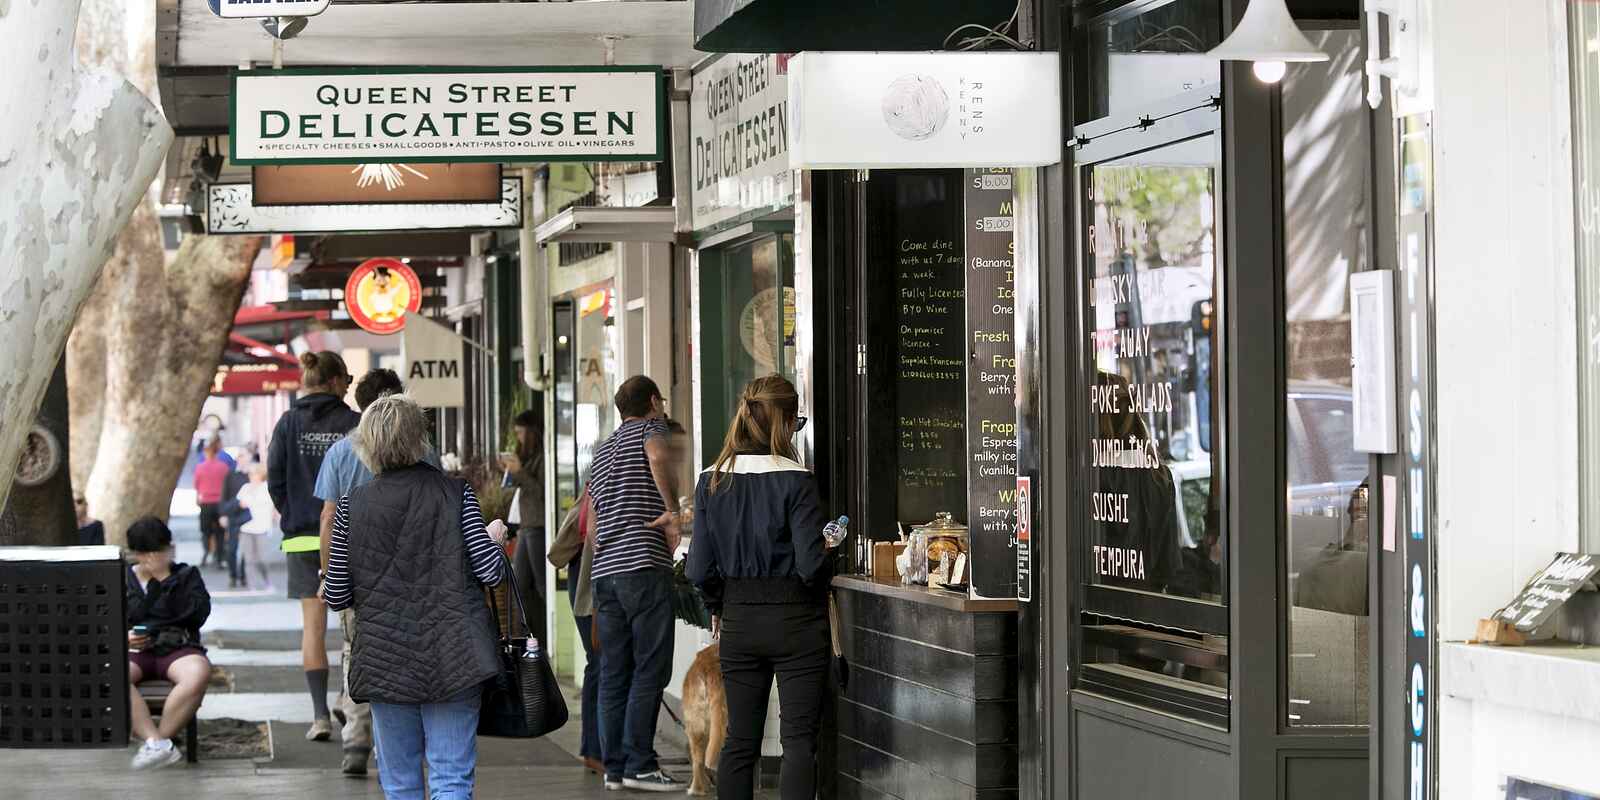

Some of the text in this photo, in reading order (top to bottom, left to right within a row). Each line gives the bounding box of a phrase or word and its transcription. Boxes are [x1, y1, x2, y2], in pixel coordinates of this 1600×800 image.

[316, 83, 577, 108] QUEEN STREET
[706, 54, 771, 120] QUEEN STREET
[972, 82, 983, 133] RENS
[259, 110, 635, 139] DELICATESSEN
[265, 143, 319, 151] SPECIALTY
[323, 142, 371, 150] CHEESES
[379, 141, 449, 150] SMALLGOODS
[523, 140, 554, 148] OLIVE
[582, 139, 635, 148] VINEGARS
[696, 101, 787, 191] DELICATESSEN
[901, 239, 928, 252] Come
[900, 255, 920, 266] with
[936, 253, 944, 264] 7
[901, 287, 925, 303] Fully
[974, 330, 1009, 343] Fresh
[409, 360, 459, 378] ATM
[980, 371, 1009, 386] Berry
[988, 384, 1011, 395] with
[1406, 232, 1426, 538] FISH
[1091, 382, 1173, 414] POKE SALADS
[974, 450, 1017, 464] milky ice
[1091, 437, 1160, 469] DUMPLINGS
[979, 506, 1010, 520] Berry
[1092, 492, 1129, 524] SUSHI
[983, 521, 1008, 532] with
[1092, 545, 1146, 580] TEMPURA
[1411, 562, 1426, 638] &
